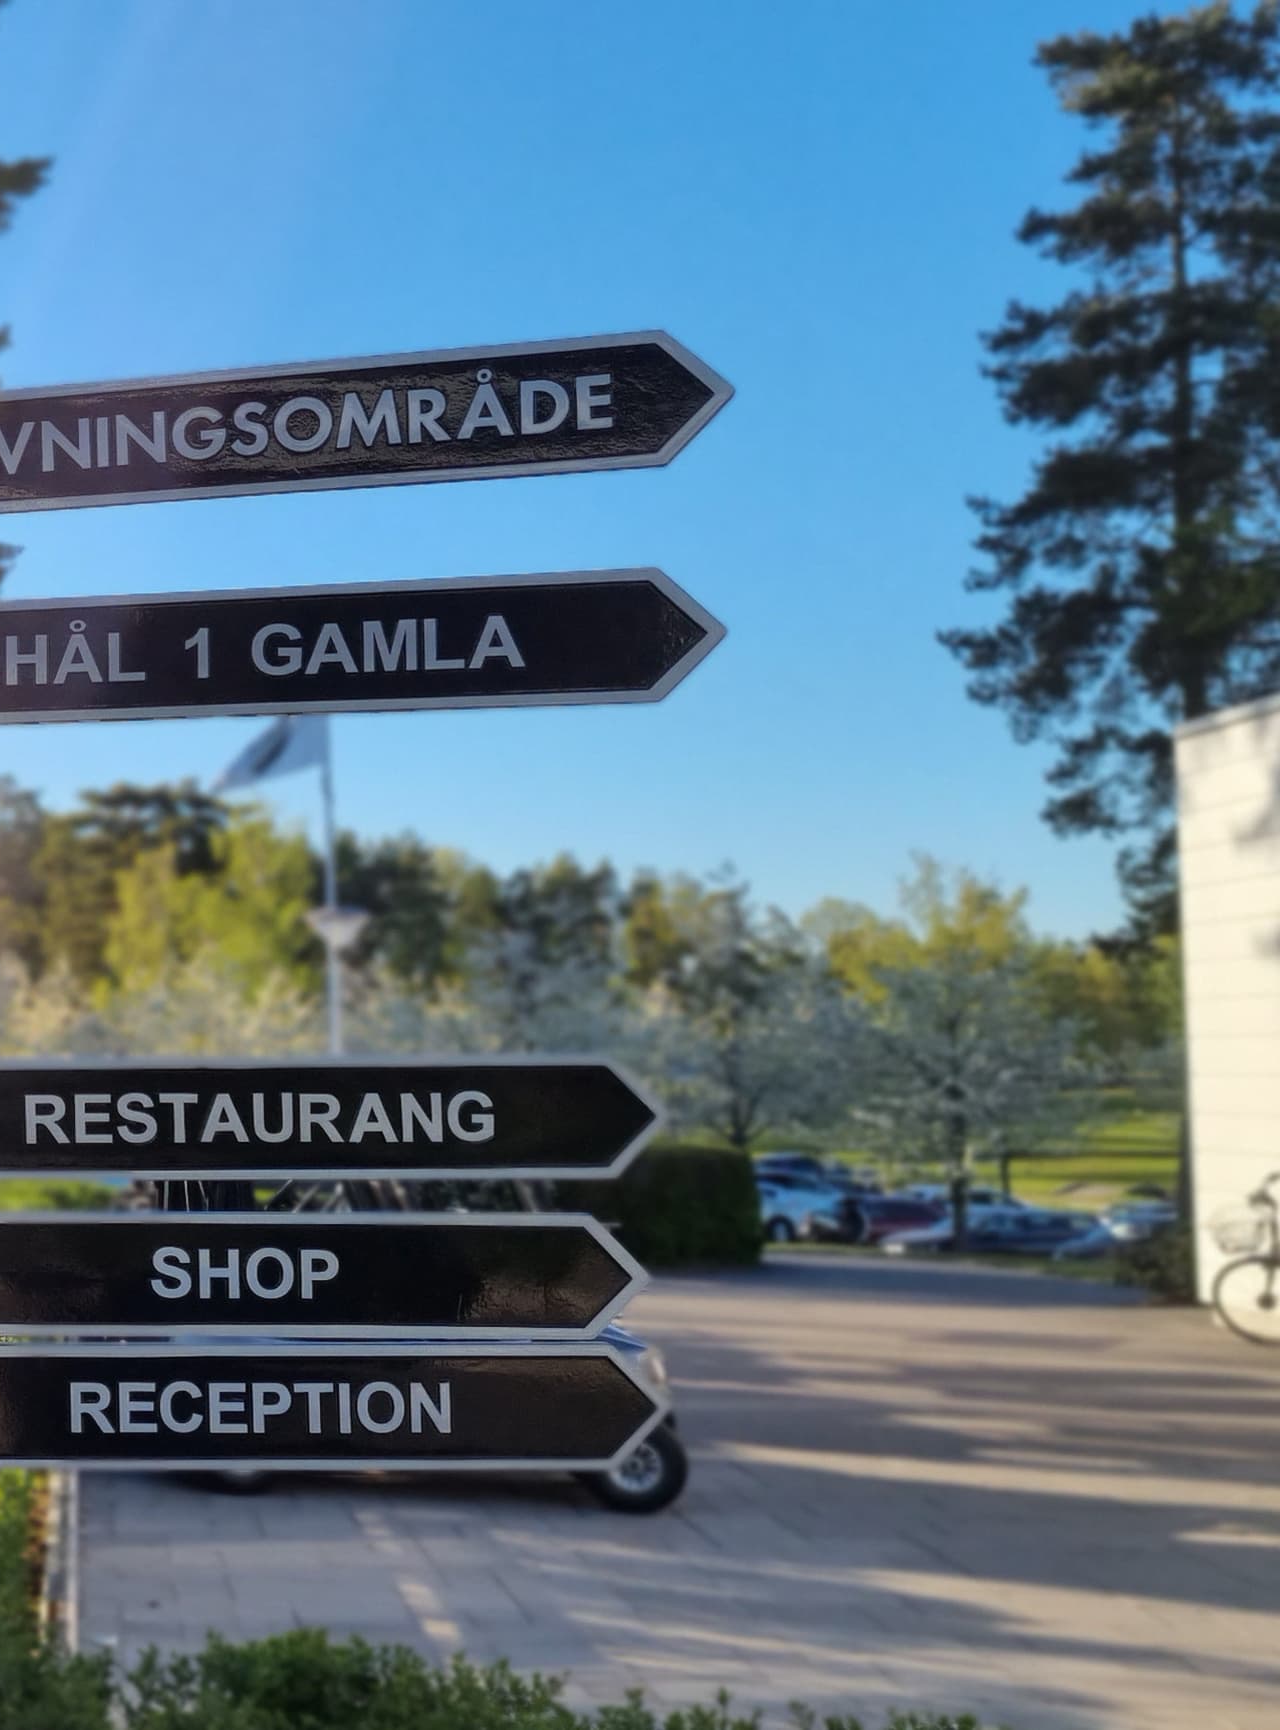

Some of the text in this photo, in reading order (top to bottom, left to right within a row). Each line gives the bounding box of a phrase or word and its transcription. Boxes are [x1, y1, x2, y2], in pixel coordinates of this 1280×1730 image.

[6, 616, 525, 685] HÅL 1 GAMLA
[25, 1091, 494, 1144] RESTAURANG
[151, 1247, 339, 1299] SHOP
[70, 1381, 451, 1433] RECEPTION
